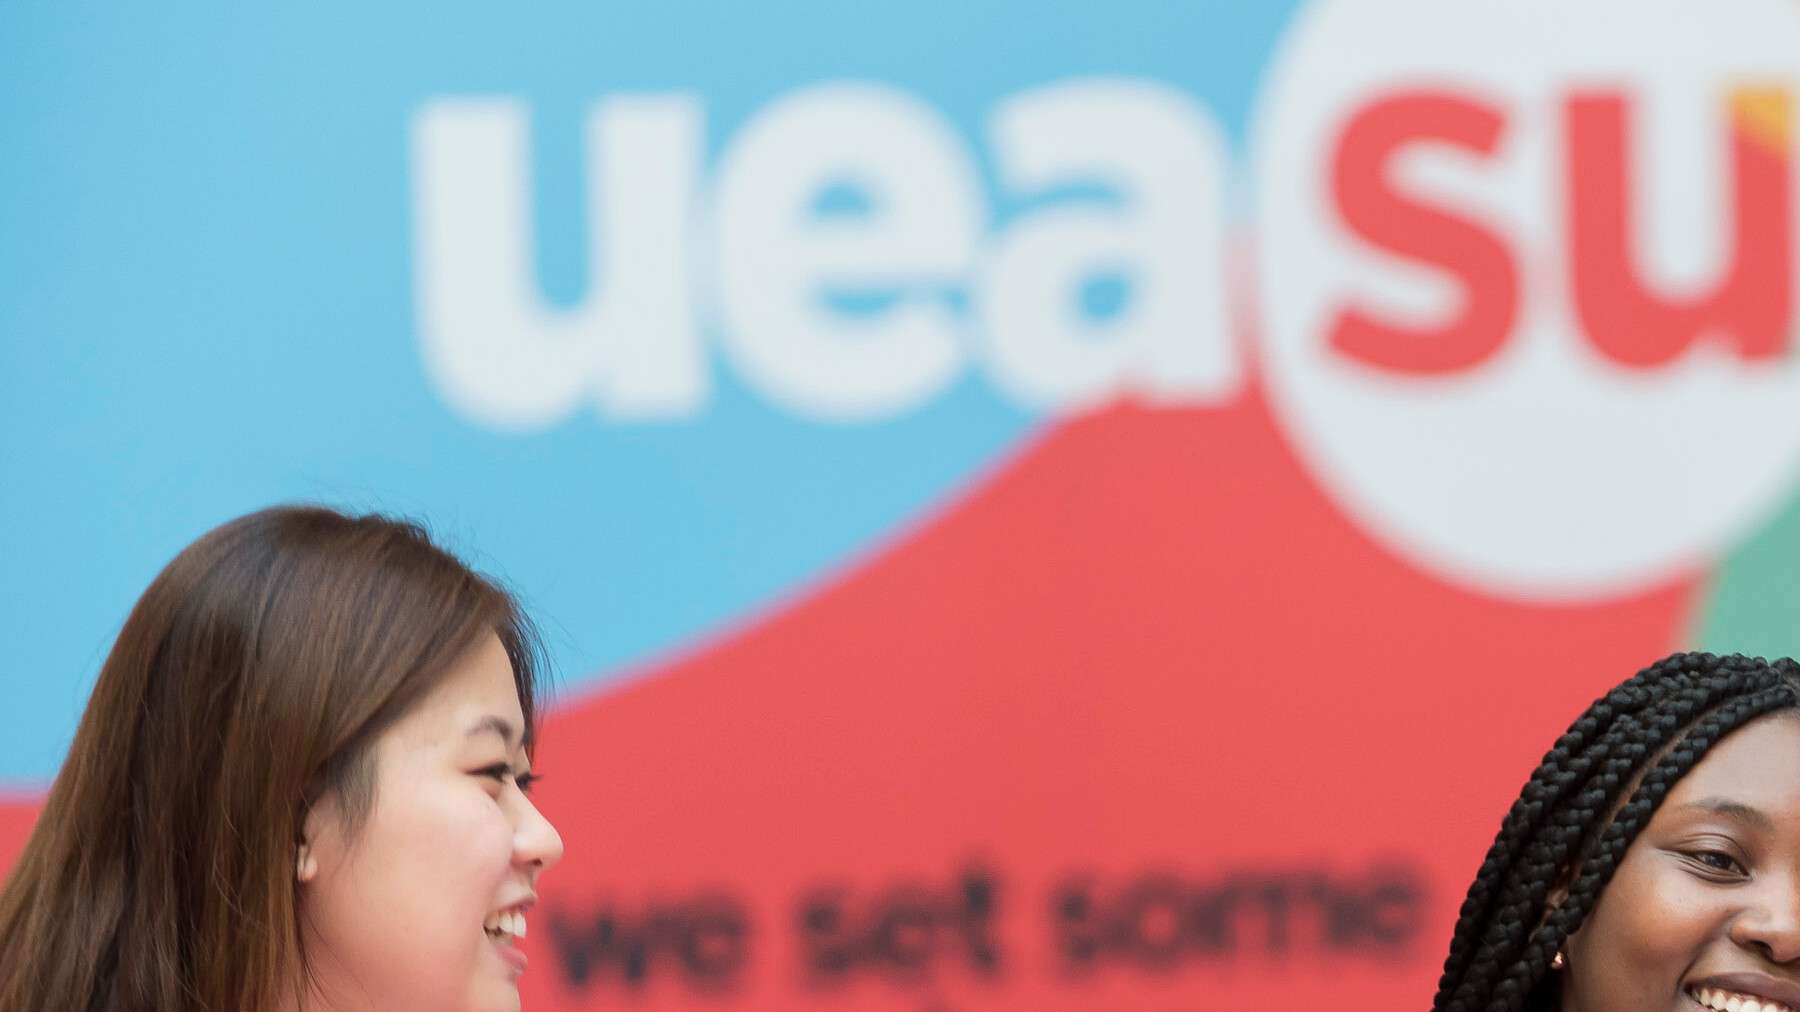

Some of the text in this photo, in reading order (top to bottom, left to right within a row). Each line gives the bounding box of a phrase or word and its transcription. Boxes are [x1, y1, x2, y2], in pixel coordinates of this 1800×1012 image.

[410, 78, 1243, 431] uea
[546, 862, 1430, 995] we set some
